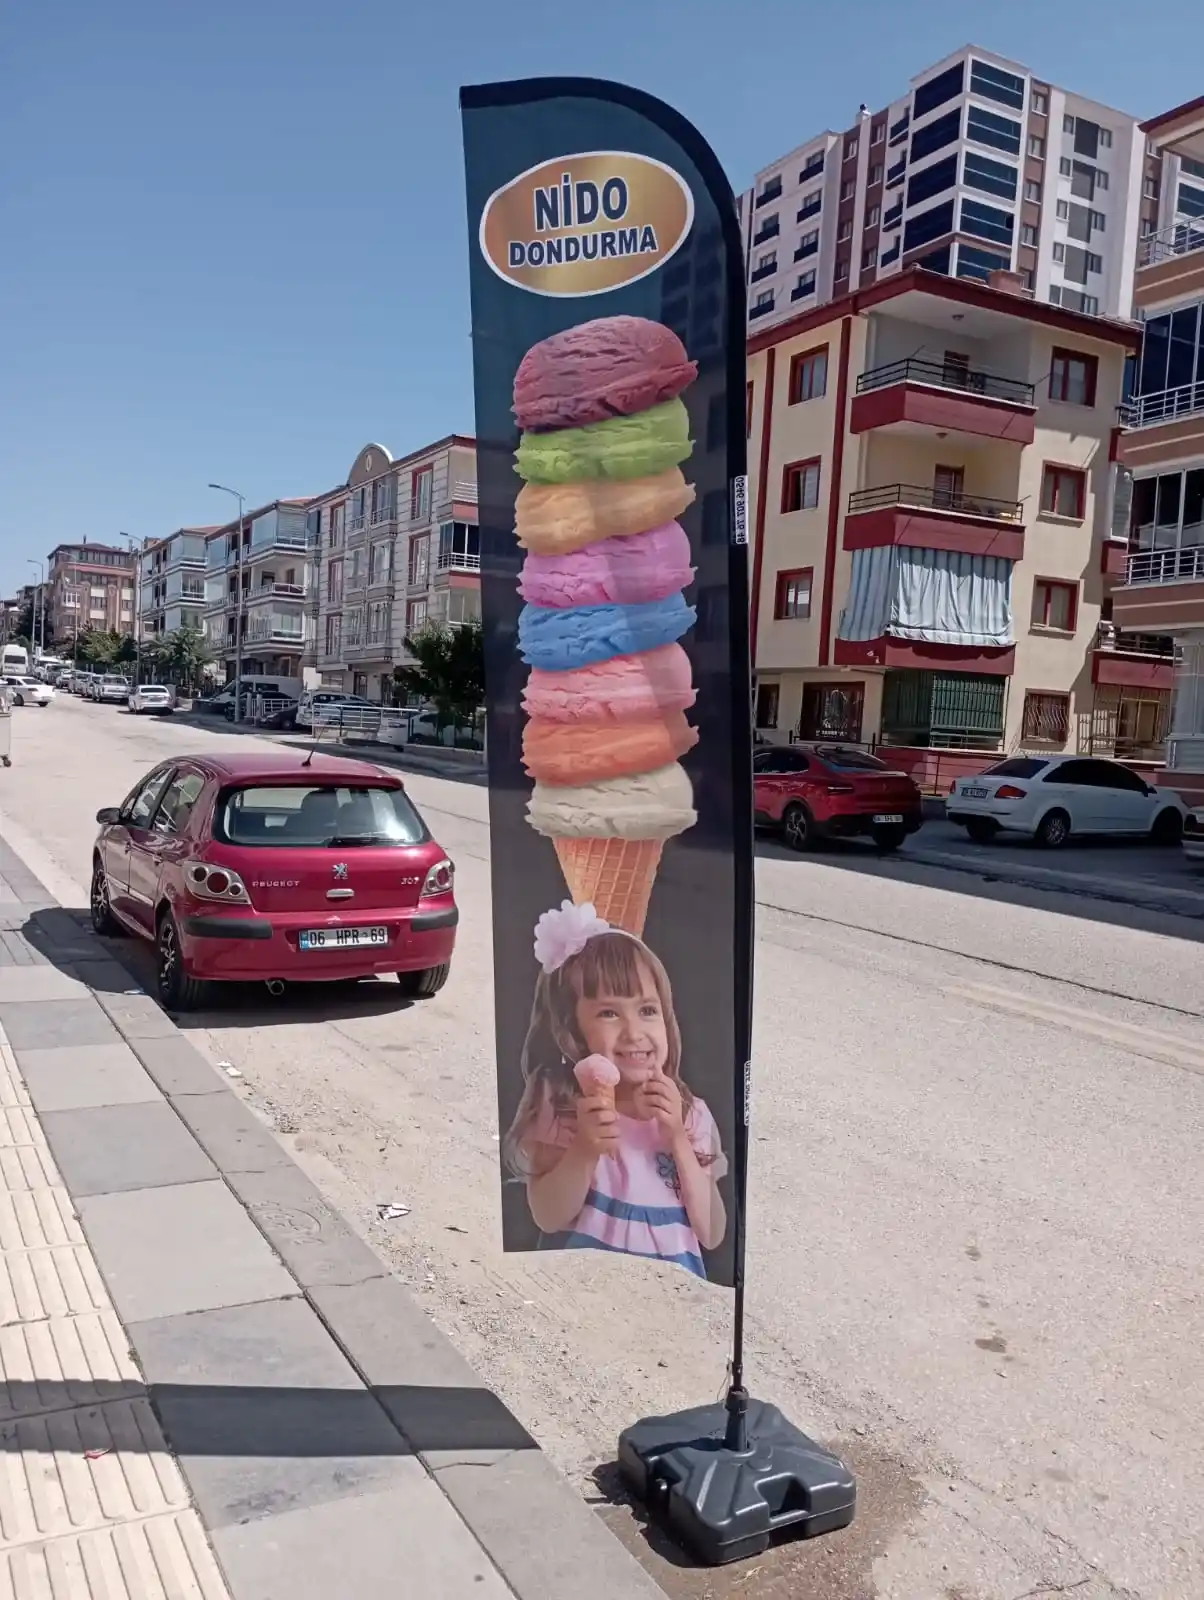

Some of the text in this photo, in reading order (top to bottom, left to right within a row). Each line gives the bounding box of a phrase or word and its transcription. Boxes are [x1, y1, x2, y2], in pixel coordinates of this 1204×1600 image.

[535, 173, 628, 230] NİDO
[509, 225, 658, 267] DONDURMA
[252, 879, 300, 888] PEUGEOT
[311, 931, 326, 946] 06
[336, 929, 359, 945] HPR
[370, 928, 385, 942] 69
